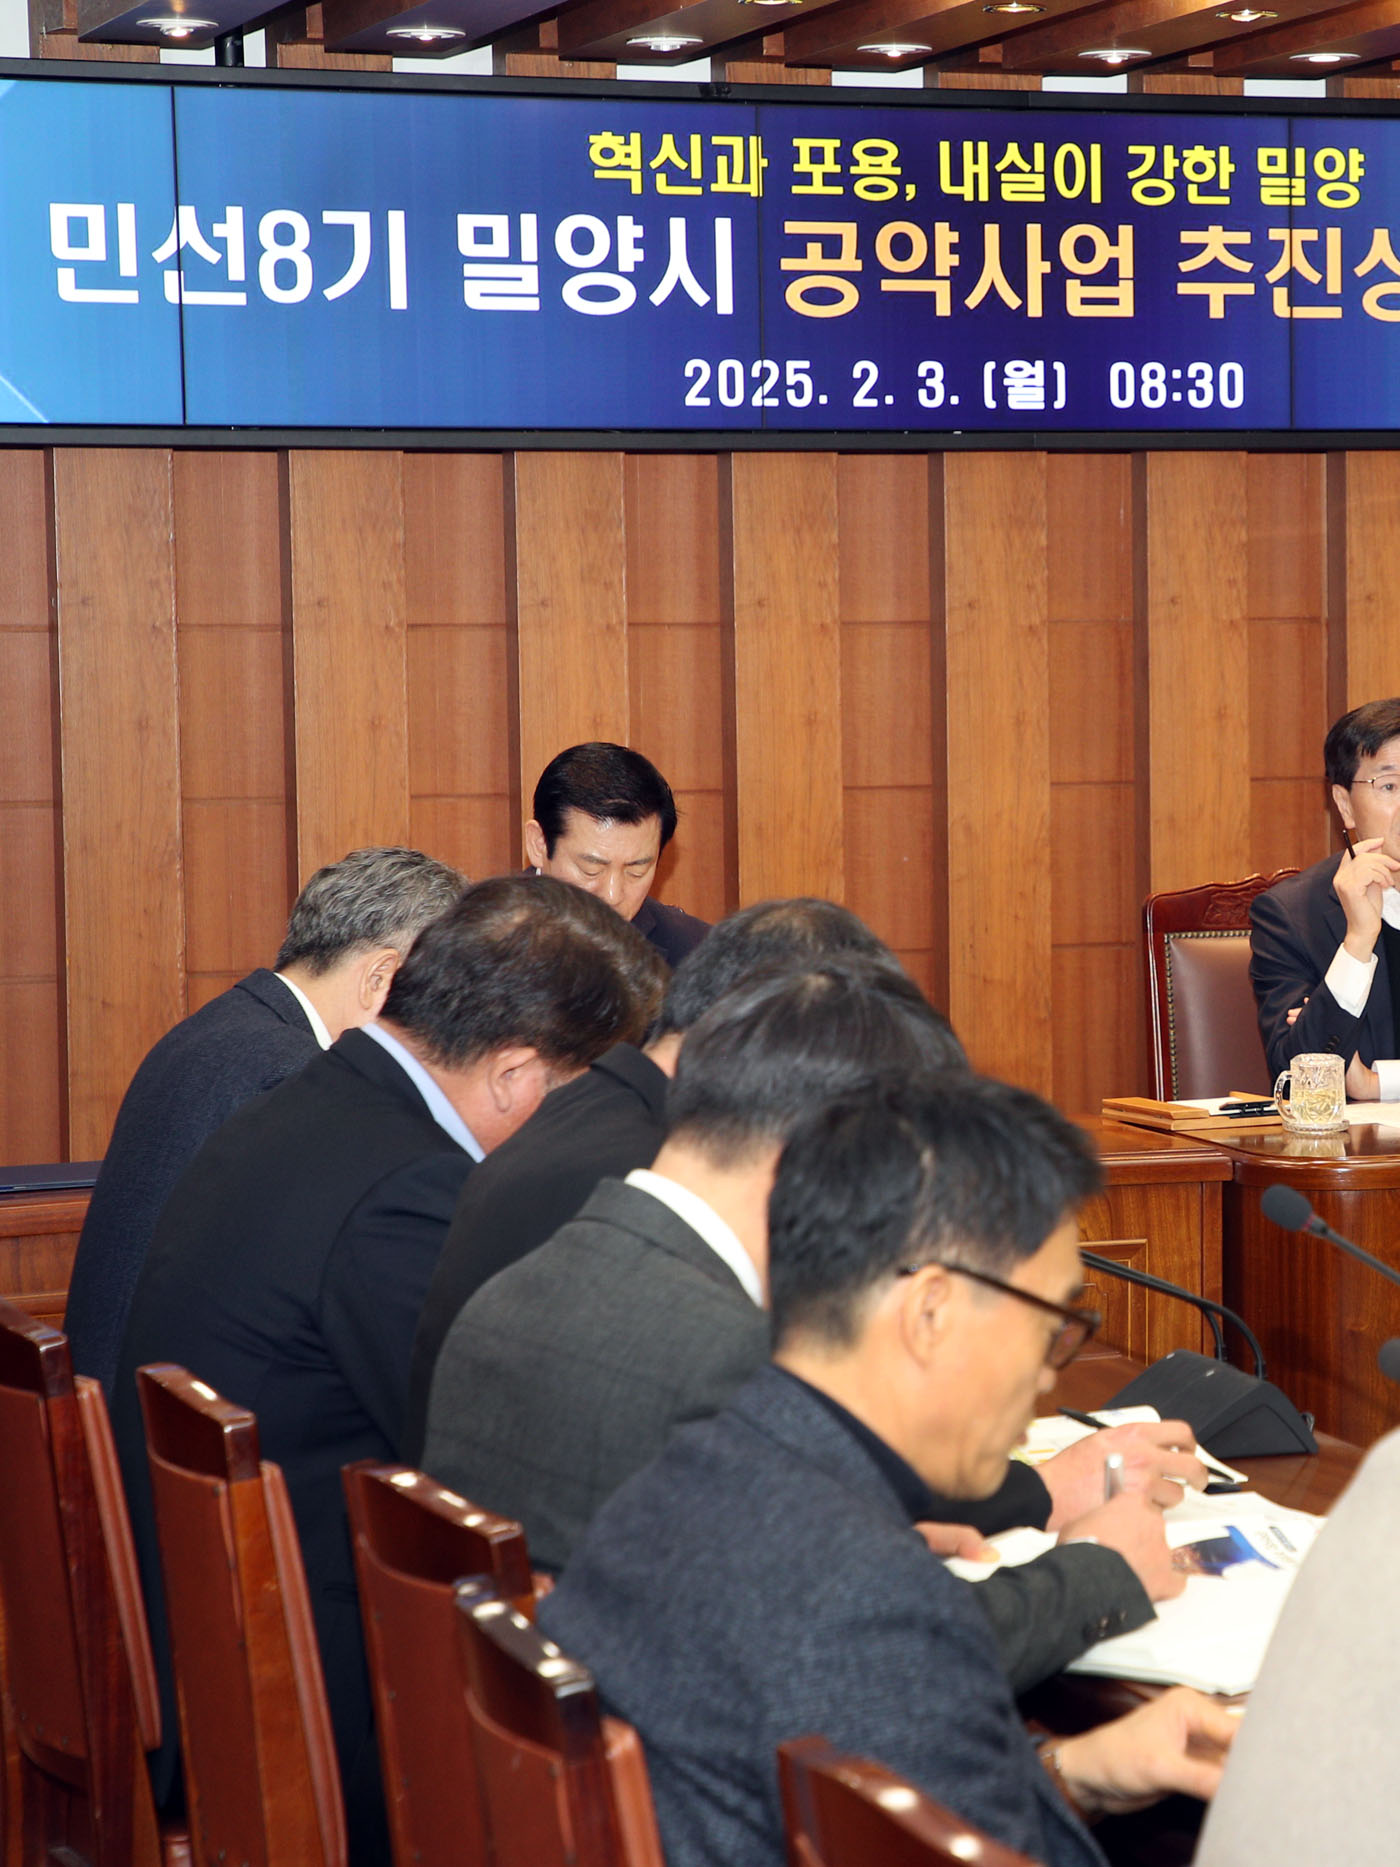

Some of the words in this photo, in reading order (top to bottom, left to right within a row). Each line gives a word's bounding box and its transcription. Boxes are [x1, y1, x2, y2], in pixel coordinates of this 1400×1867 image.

[588, 131, 768, 197] 혁신과
[791, 137, 917, 202] 포용,
[939, 140, 1102, 204] 내실이
[1127, 144, 1236, 206] 강한
[1257, 146, 1366, 209] 밀양
[49, 202, 408, 311] 민선8기
[457, 213, 734, 316] 밀양시
[780, 220, 1135, 319] 공약사업
[684, 358, 829, 408] 2025.
[852, 360, 895, 408] 2.
[917, 360, 960, 408] 3.
[983, 360, 1066, 411] (월)
[1109, 361, 1245, 409] 08:30
